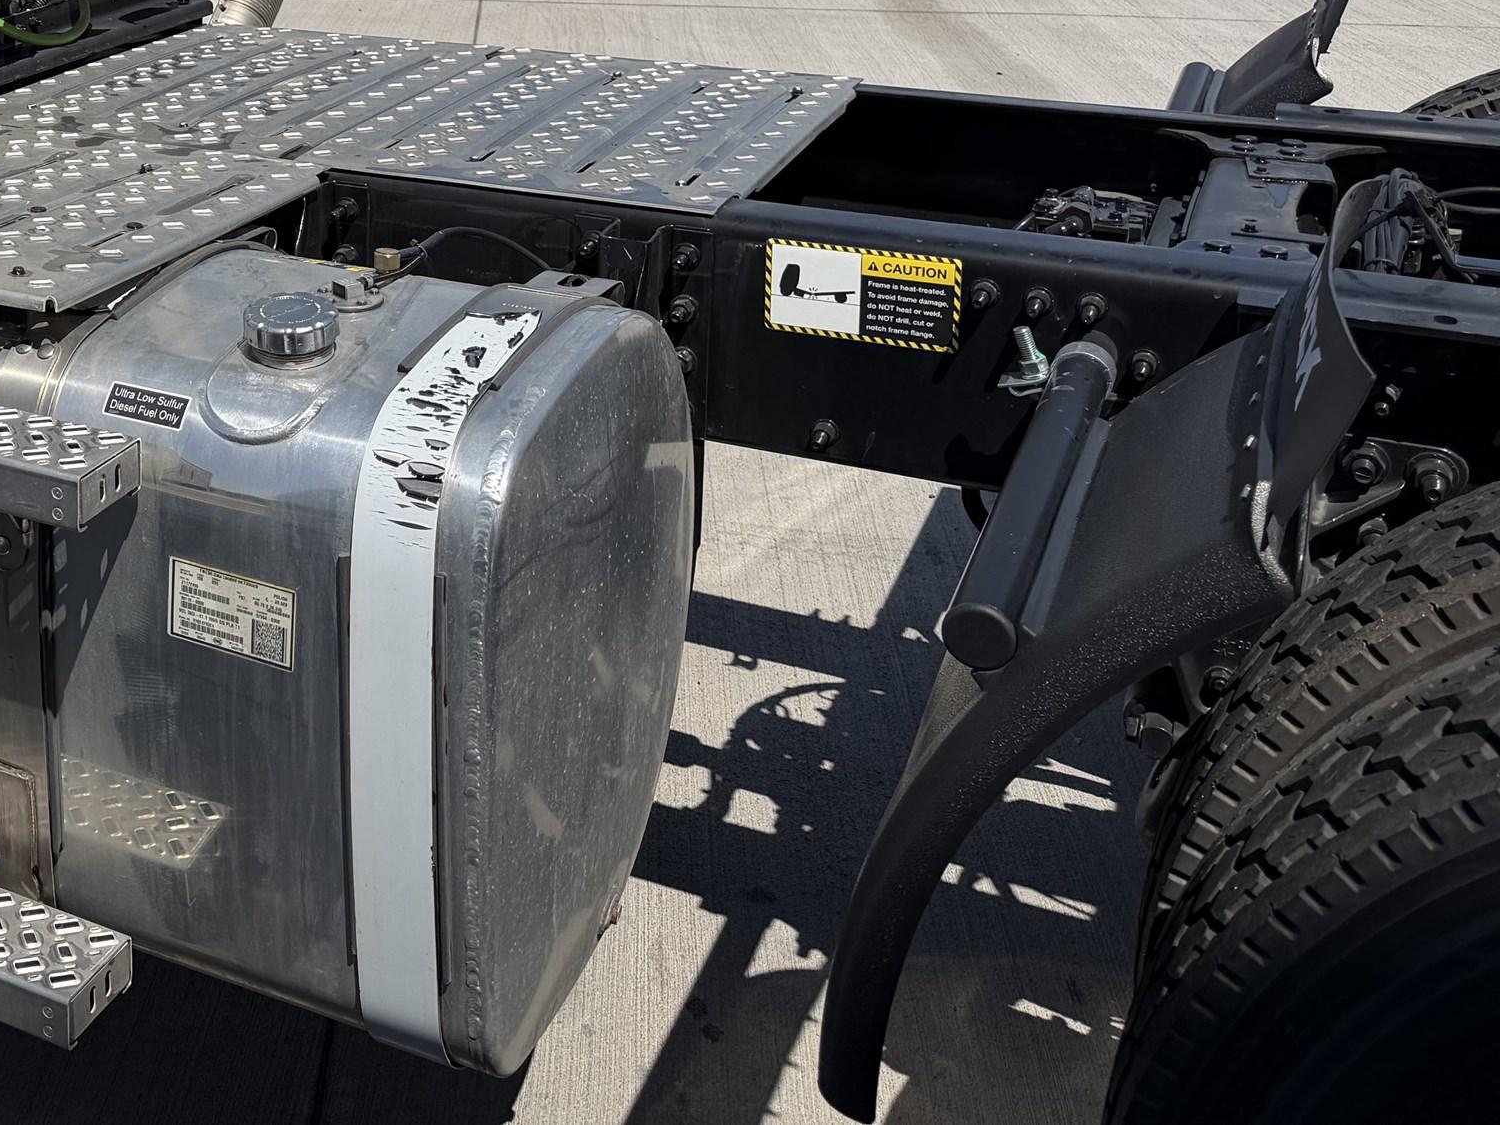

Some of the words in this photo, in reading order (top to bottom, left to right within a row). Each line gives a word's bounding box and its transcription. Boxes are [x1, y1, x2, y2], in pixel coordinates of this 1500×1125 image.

[883, 263, 947, 279] CAUTION
[868, 281, 890, 289] Frame
[897, 295, 917, 303] frame
[888, 327, 909, 335] frame
[910, 330, 934, 339] flange.
[114, 387, 136, 399] Ultra
[137, 391, 156, 404] Low
[157, 396, 184, 410] Sulfur
[109, 399, 137, 413] Diesel
[138, 405, 158, 418] Fuel
[159, 410, 180, 425] Only
